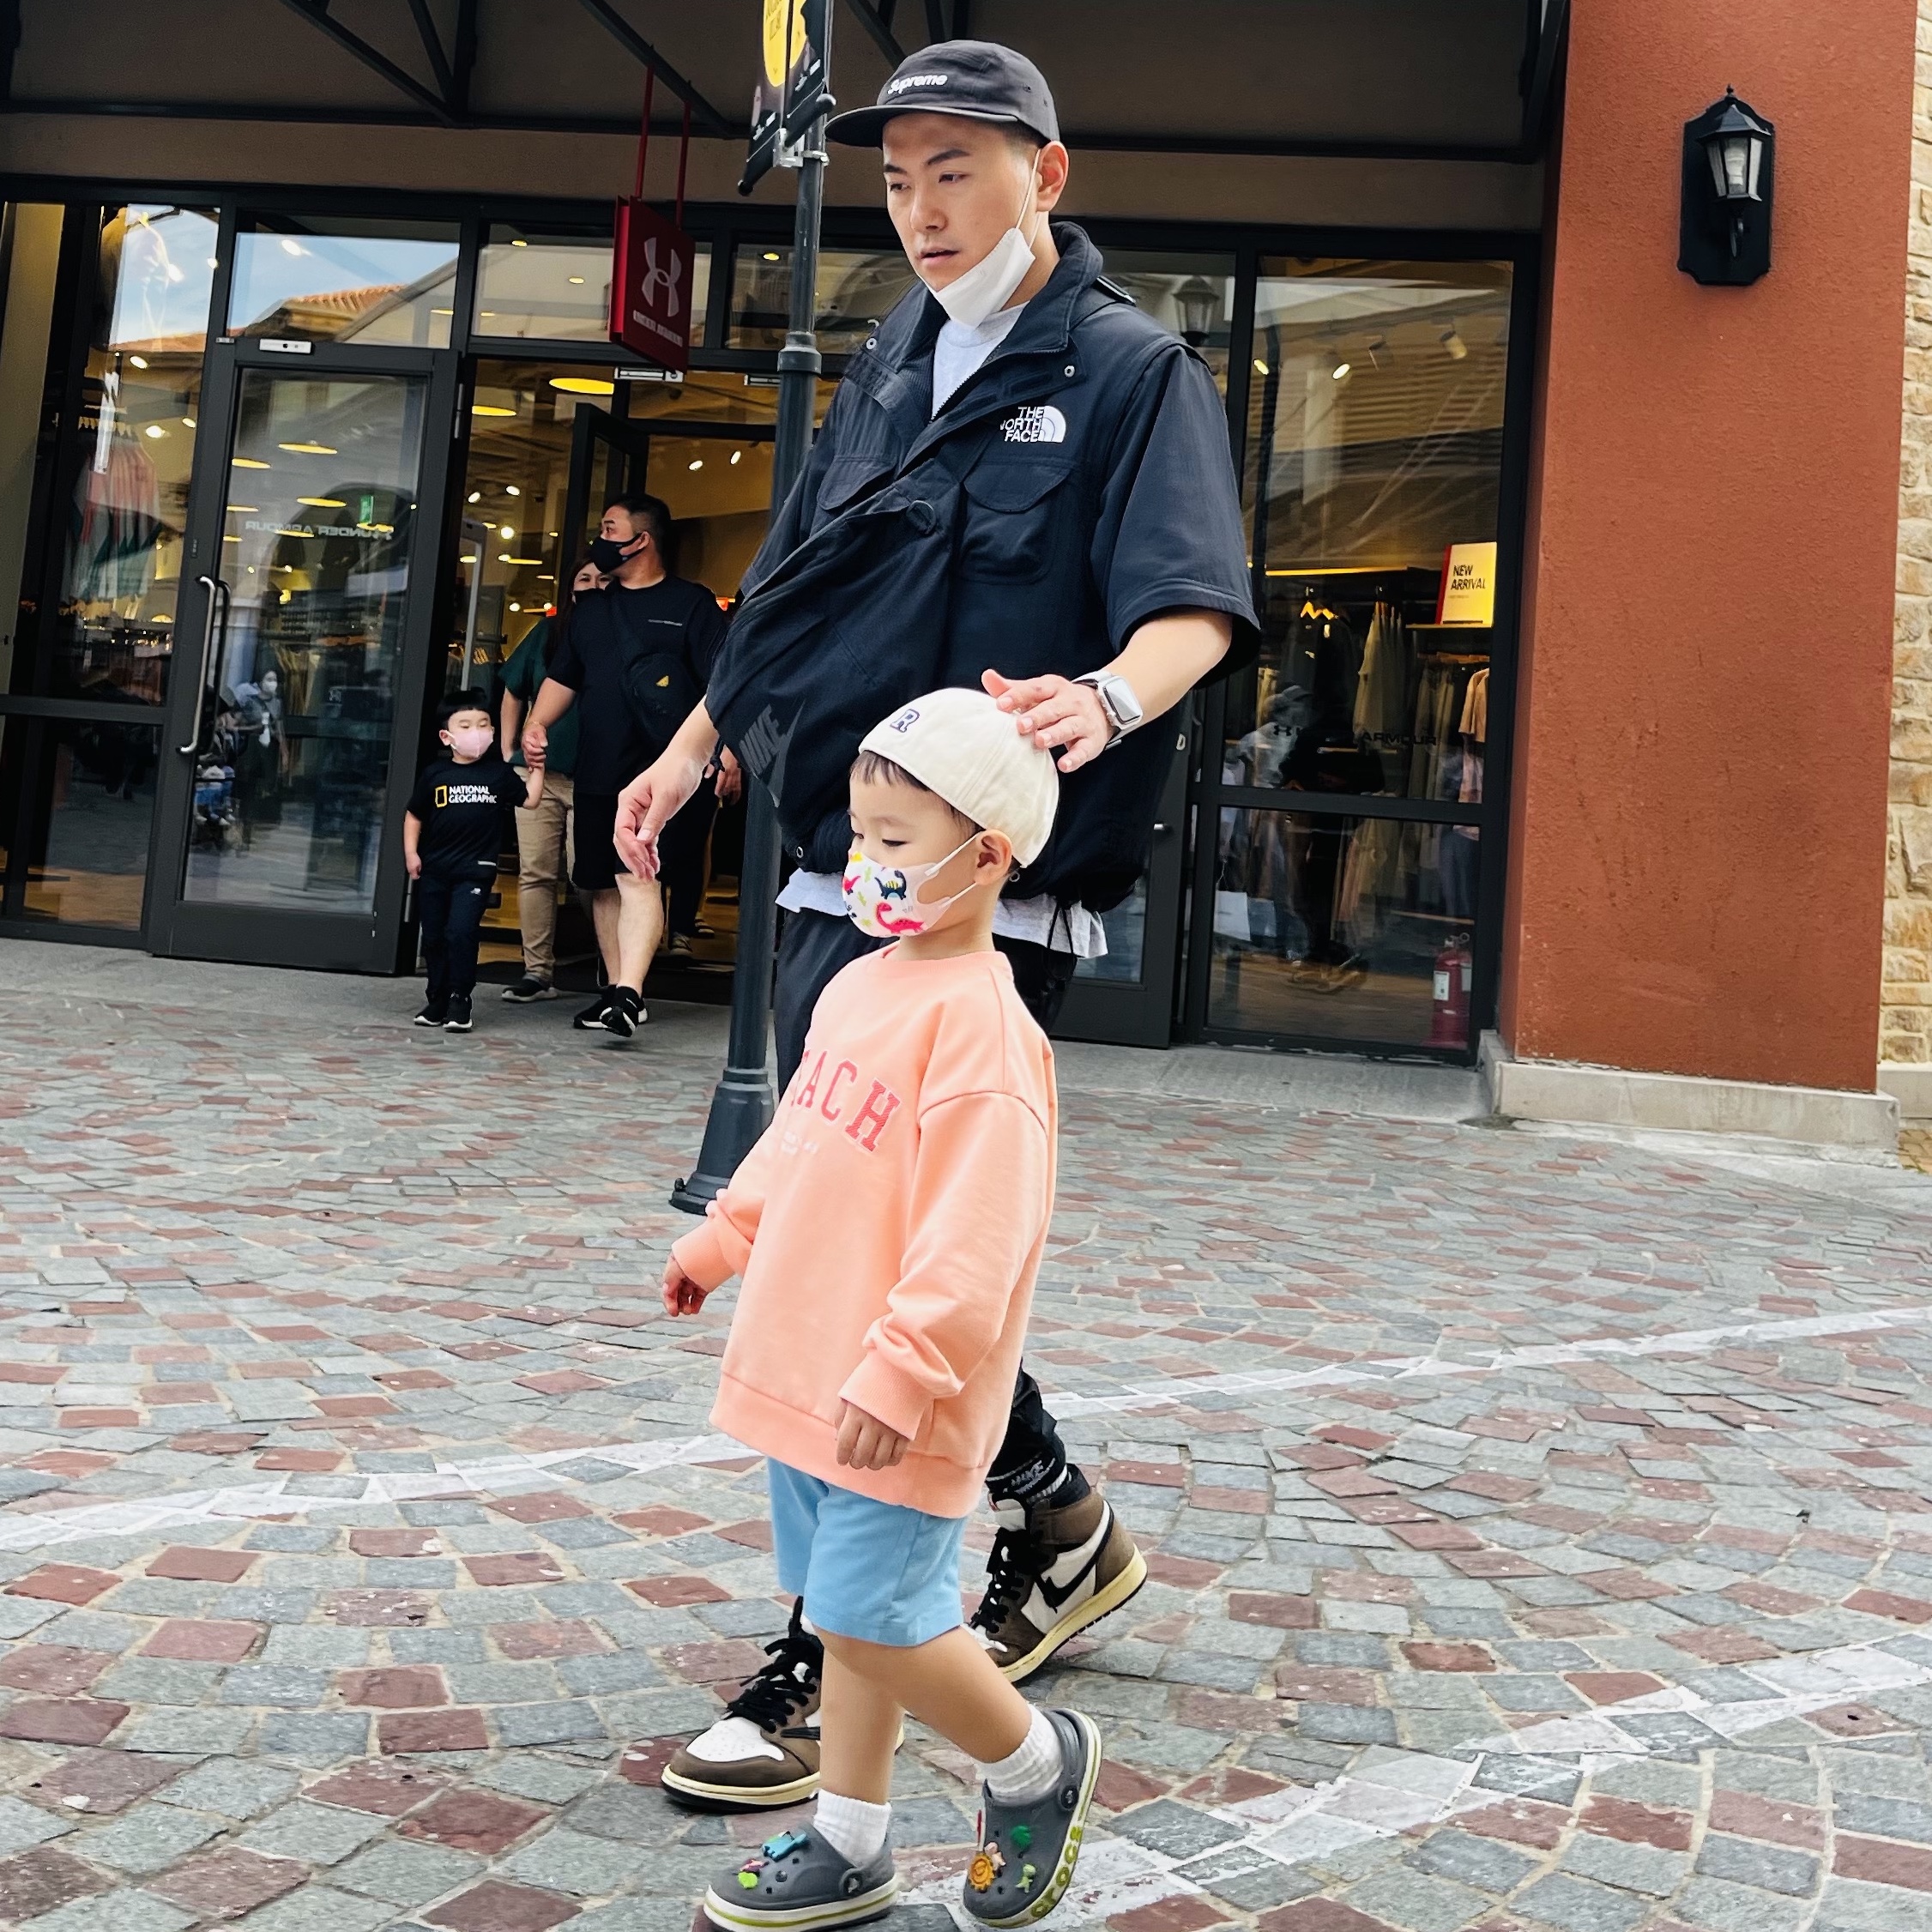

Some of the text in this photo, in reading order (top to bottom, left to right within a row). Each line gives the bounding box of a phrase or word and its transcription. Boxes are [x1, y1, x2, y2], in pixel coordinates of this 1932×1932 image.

[1017, 406, 1046, 419] THE
[1004, 429, 1038, 443] FACE
[1452, 564, 1474, 577] NEW
[1451, 578, 1486, 590] ARRIVAL
[890, 709, 920, 733] R
[739, 703, 786, 779] NIKE
[449, 785, 490, 794] NATIONAL
[790, 1048, 901, 1153] ACH
